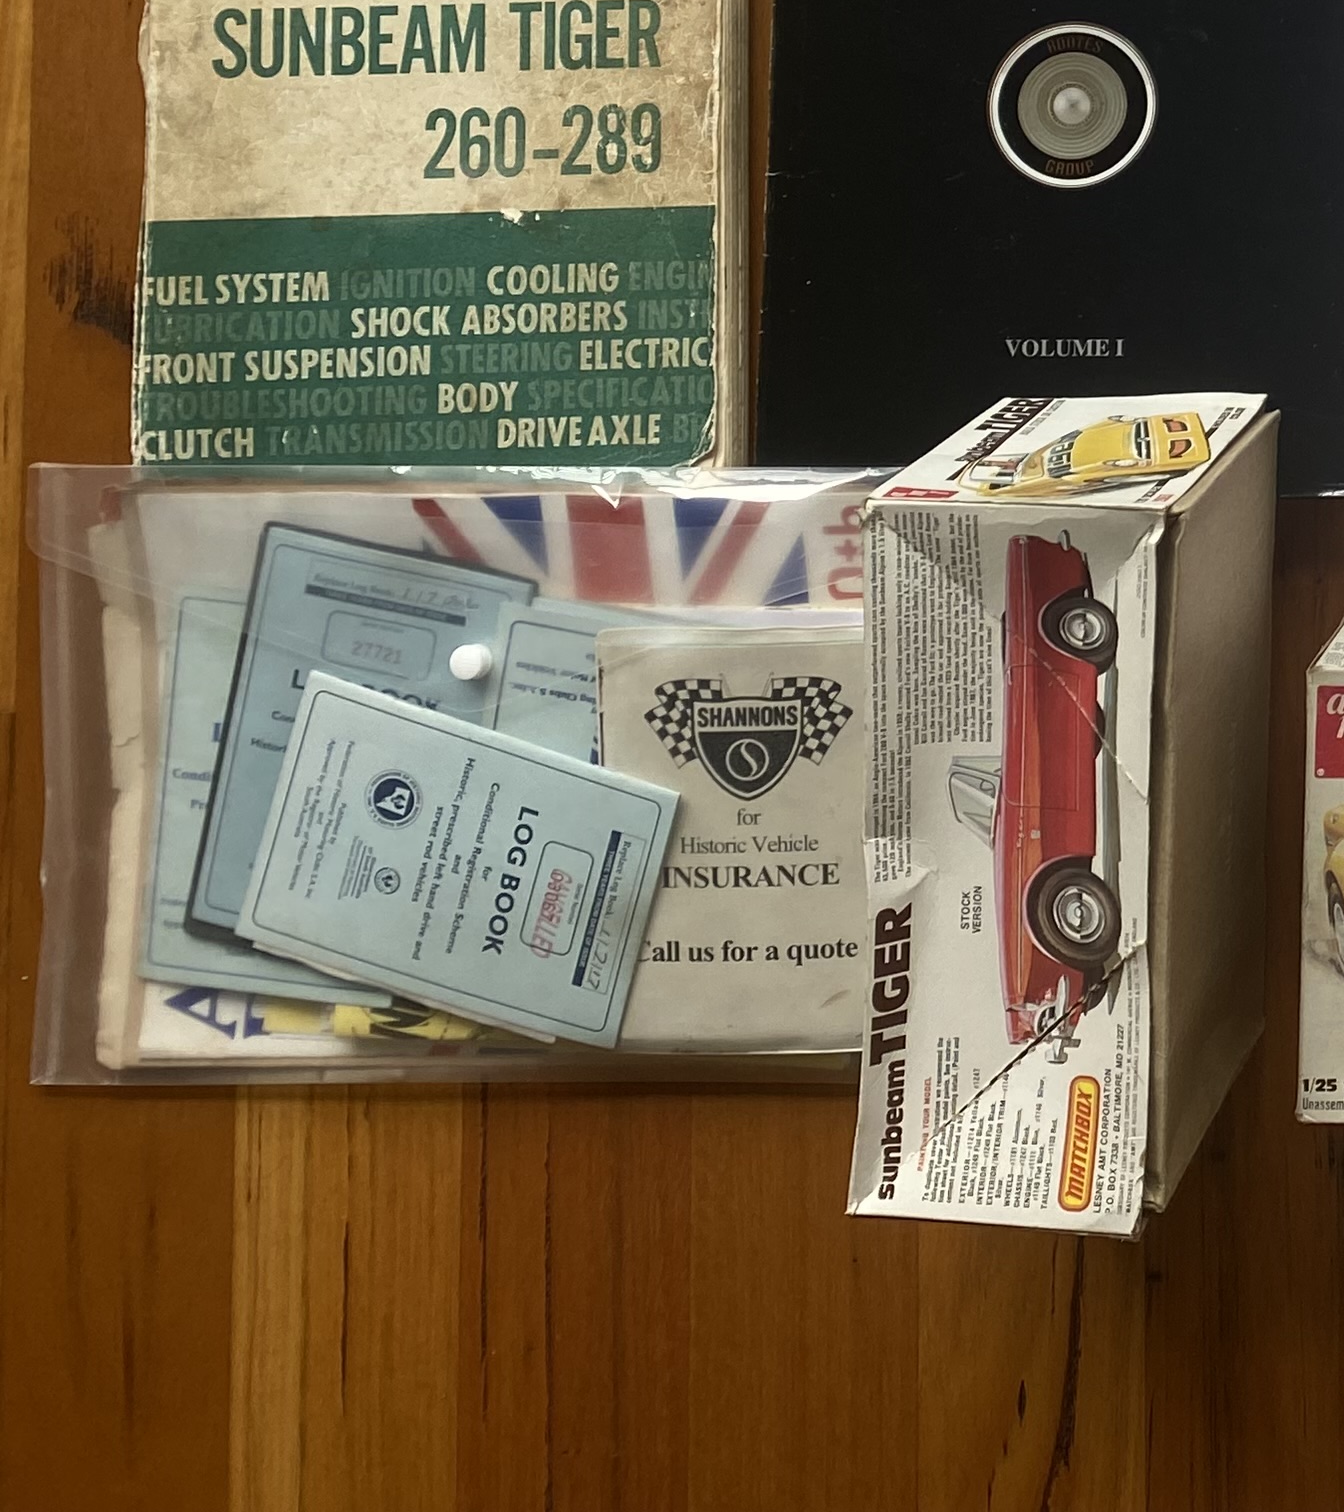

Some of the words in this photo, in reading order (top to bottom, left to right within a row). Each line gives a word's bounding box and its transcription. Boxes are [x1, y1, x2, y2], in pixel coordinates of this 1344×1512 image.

[212, 4, 486, 79] SUNBEAM
[510, 0, 662, 70] TIGER
[424, 102, 662, 179] 260-289
[1005, 339, 1112, 358] VOLUME
[1115, 339, 1124, 356] I
[696, 704, 798, 728] SHANNONS
[736, 808, 762, 827] for
[506, 806, 539, 868] LOG
[680, 836, 747, 855] Historic
[752, 834, 819, 854] Vehicle
[664, 863, 840, 889] INSURANCE
[481, 872, 521, 955] BOOK
[870, 902, 912, 1068] TIGER
[1303, 1077, 1338, 1093] 1/25
